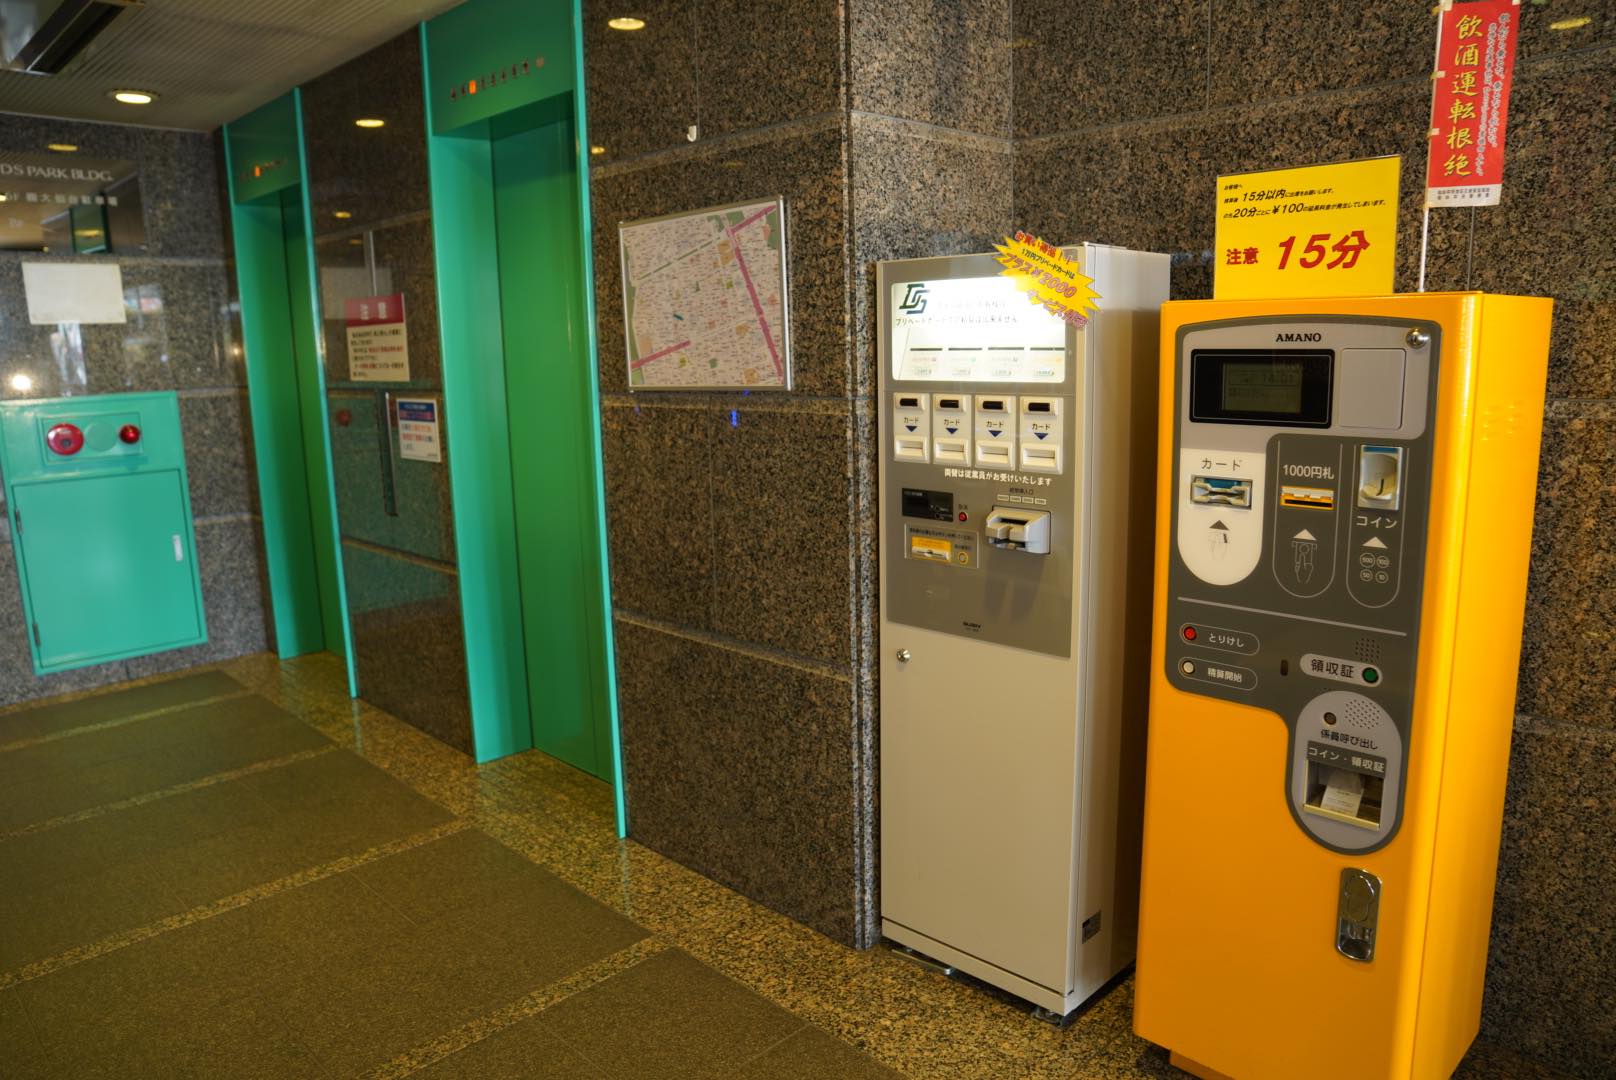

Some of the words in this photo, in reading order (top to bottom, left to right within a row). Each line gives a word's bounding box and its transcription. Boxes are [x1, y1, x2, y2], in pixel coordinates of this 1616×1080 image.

[1443, 14, 1484, 178] 飲酒運転根絶
[26, 165, 68, 180] PARK
[1225, 246, 1260, 266] 注意
[1278, 230, 1371, 271] 15分
[1275, 333, 1322, 343] AMANO
[943, 418, 961, 426] カード
[986, 420, 1005, 428] カード
[1031, 423, 1051, 431] カード
[1201, 457, 1243, 471] カード
[1281, 464, 1335, 479] 1000円札
[943, 467, 1053, 487] 両替は従業員がお受けいたします
[1355, 515, 1399, 529] コイン
[1208, 632, 1245, 648] とりけし
[1207, 667, 1243, 683] 精算開始
[1310, 658, 1355, 680] 領収証
[1319, 728, 1379, 750] 係員呼び出し
